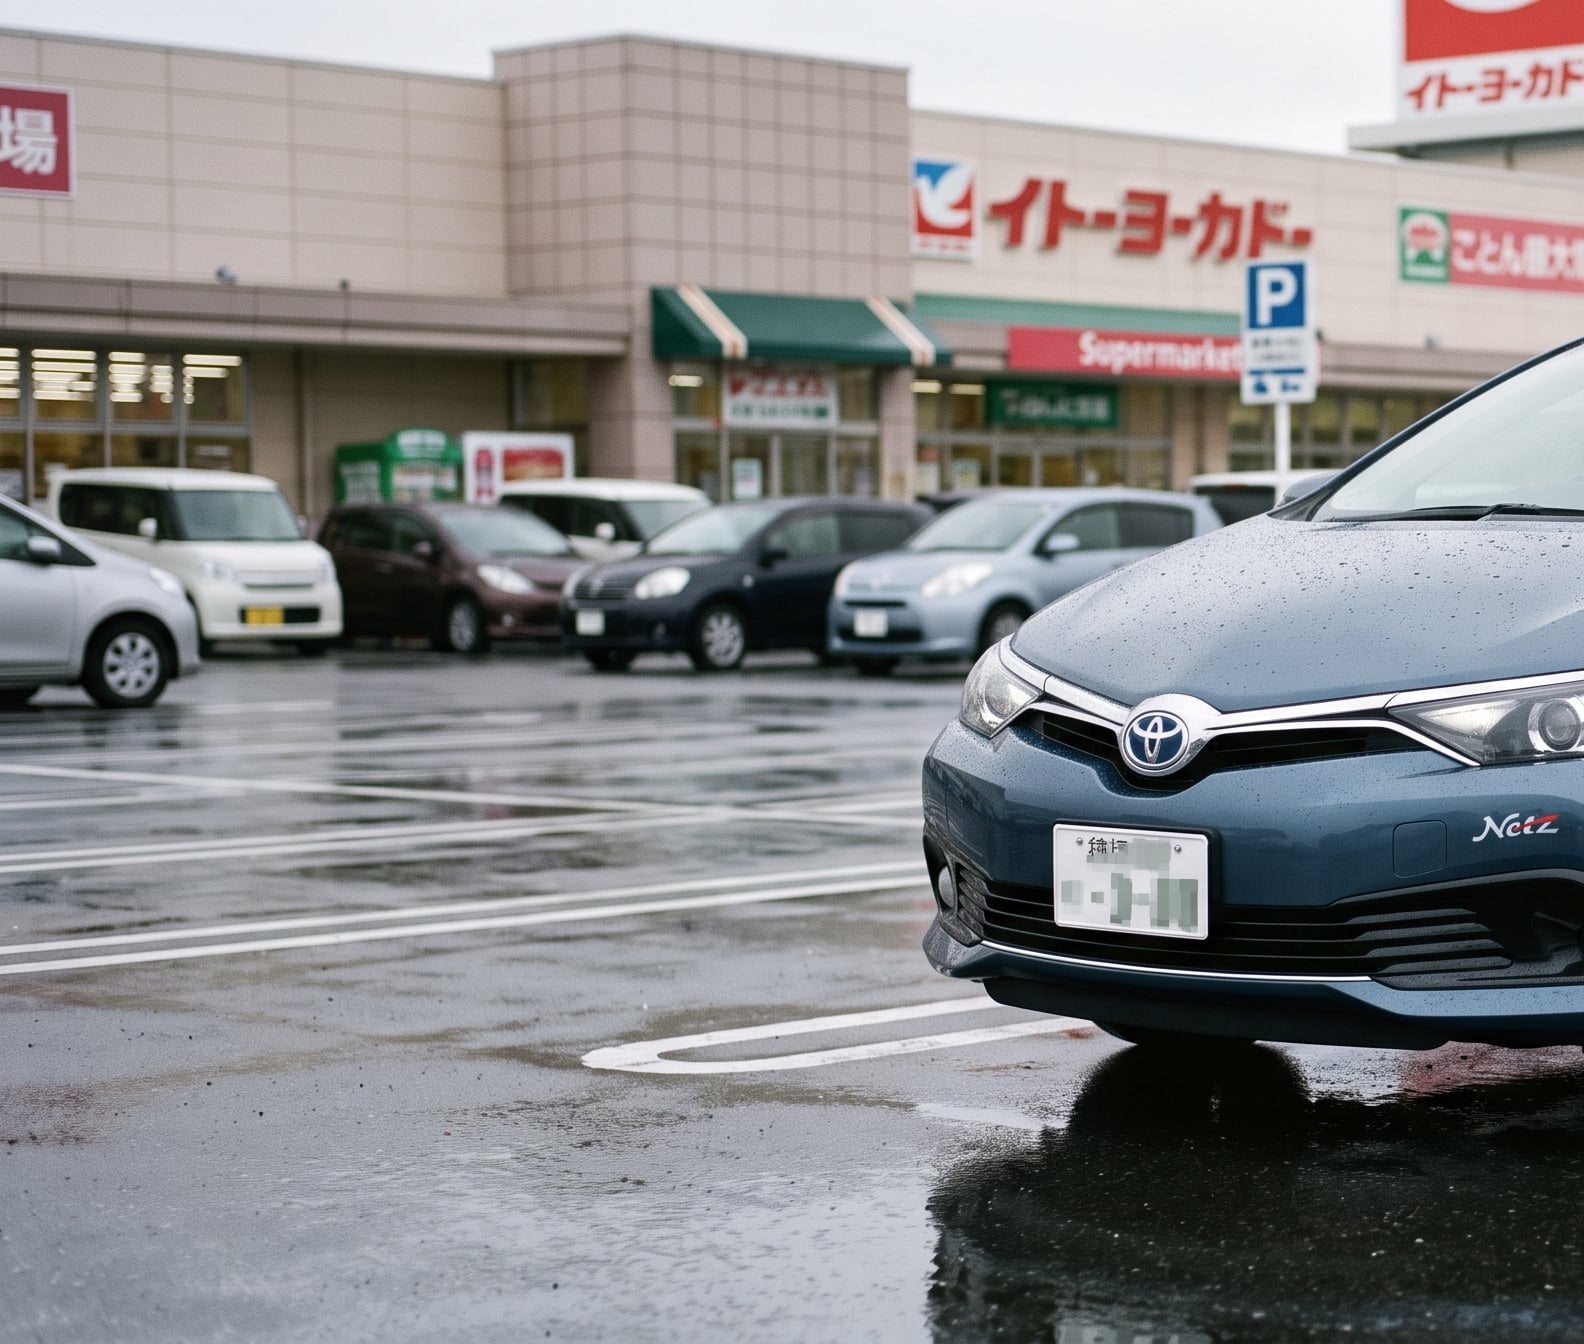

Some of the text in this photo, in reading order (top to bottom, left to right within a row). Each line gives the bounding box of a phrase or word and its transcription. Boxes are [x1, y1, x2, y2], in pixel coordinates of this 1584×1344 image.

[986, 178, 1312, 262] イトーヨーカドー
[1256, 267, 1298, 326] P
[1472, 813, 1560, 842] Netz
